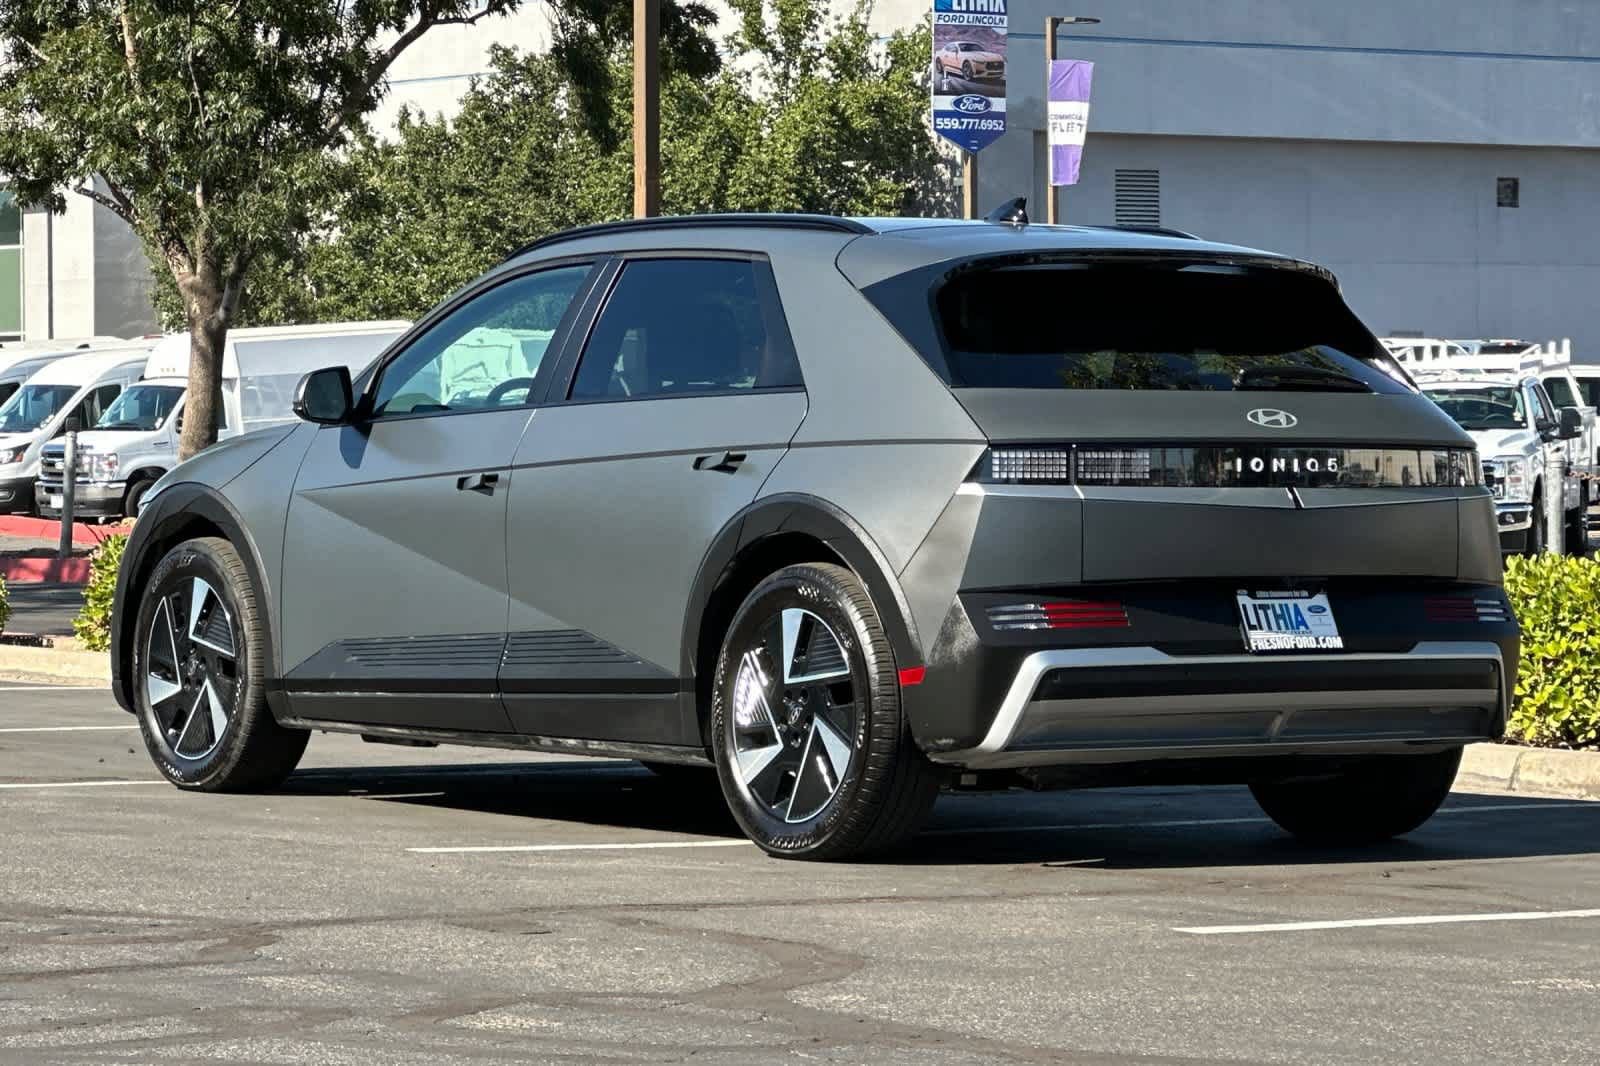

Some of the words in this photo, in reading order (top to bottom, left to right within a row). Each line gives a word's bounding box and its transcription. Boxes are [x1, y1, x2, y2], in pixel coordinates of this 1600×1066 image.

[937, 14, 965, 23] FORD
[966, 15, 1005, 25] LINCOLN
[960, 96, 986, 110] Ford
[935, 117, 1005, 131] 559.777.6952
[1241, 603, 1310, 631] LITHIA
[1250, 636, 1344, 651] FRESNOFORD.COM
